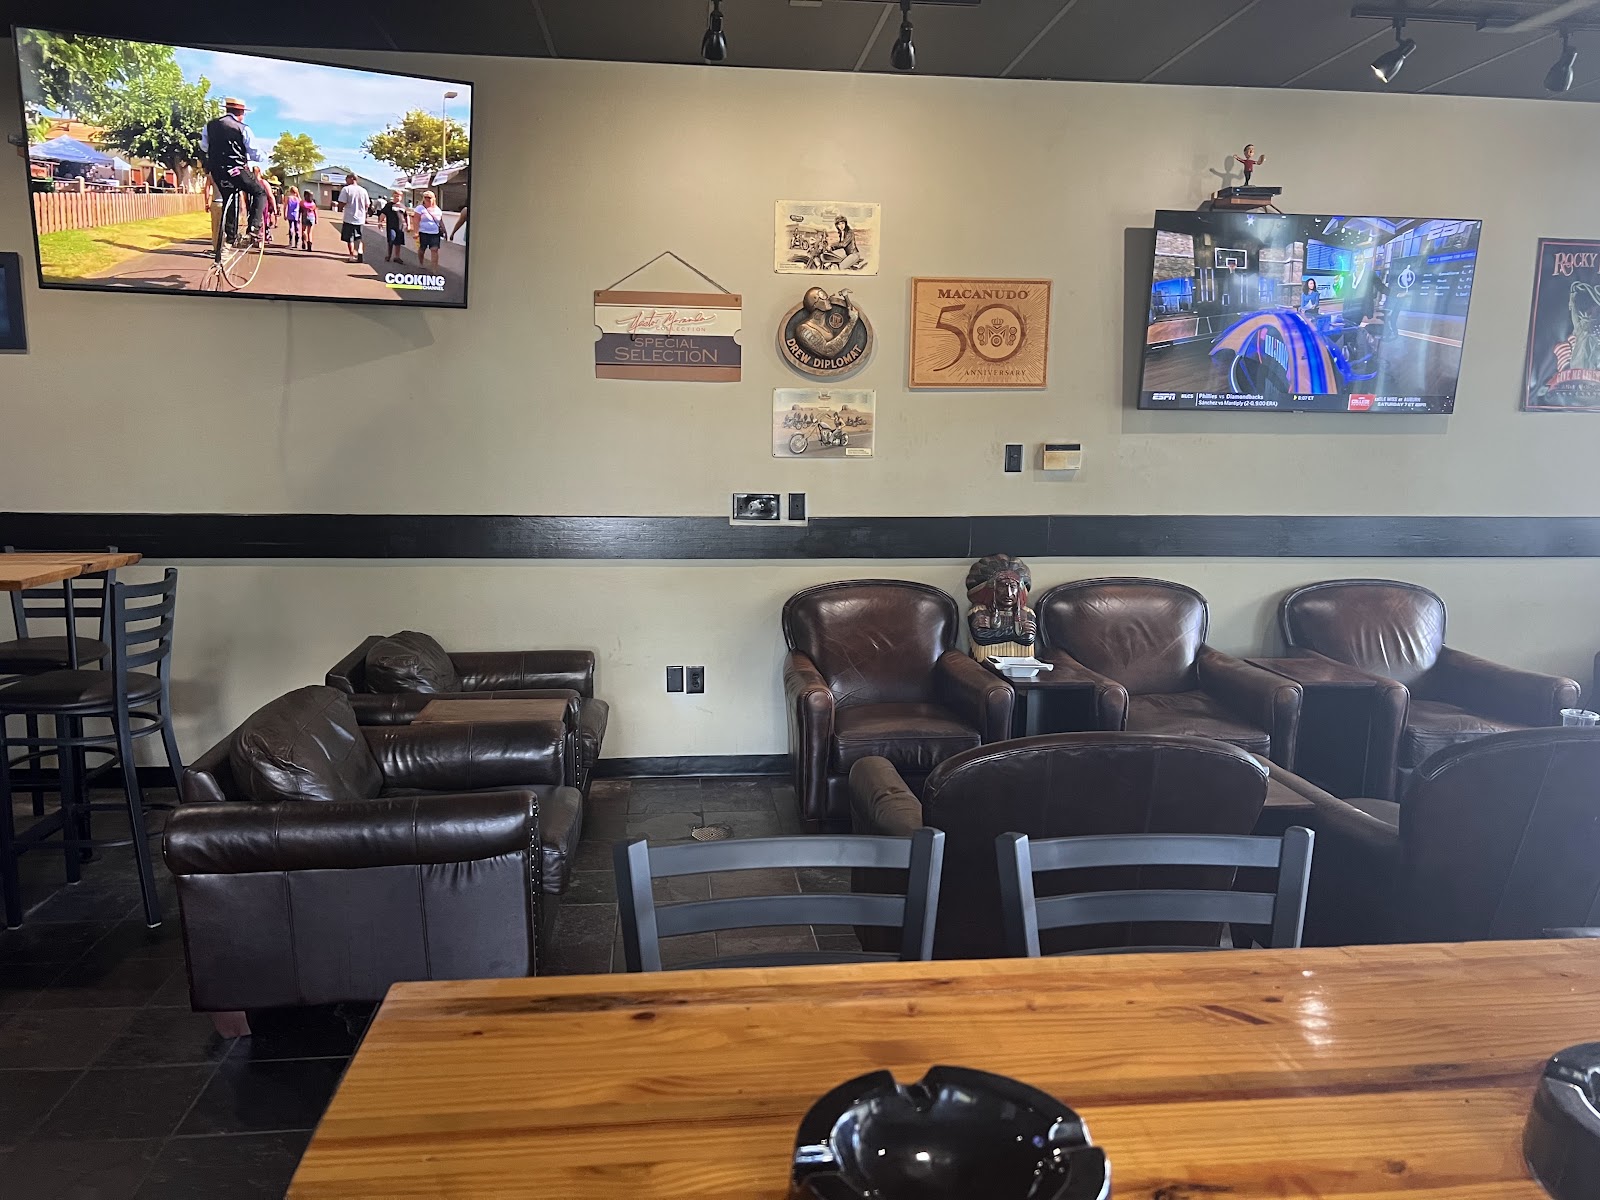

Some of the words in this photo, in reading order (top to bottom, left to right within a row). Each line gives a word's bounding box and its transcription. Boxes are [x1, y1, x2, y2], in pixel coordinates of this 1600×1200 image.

[1551, 252, 1598, 276] ROCKY
[385, 273, 445, 286] COOKING
[937, 289, 1029, 300] MACANUDO
[634, 338, 700, 349] SPECIAL
[933, 303, 1026, 372] 50
[614, 347, 718, 363] SELECTION
[786, 338, 811, 364] DREW
[813, 344, 862, 369] DIPLOMAT
